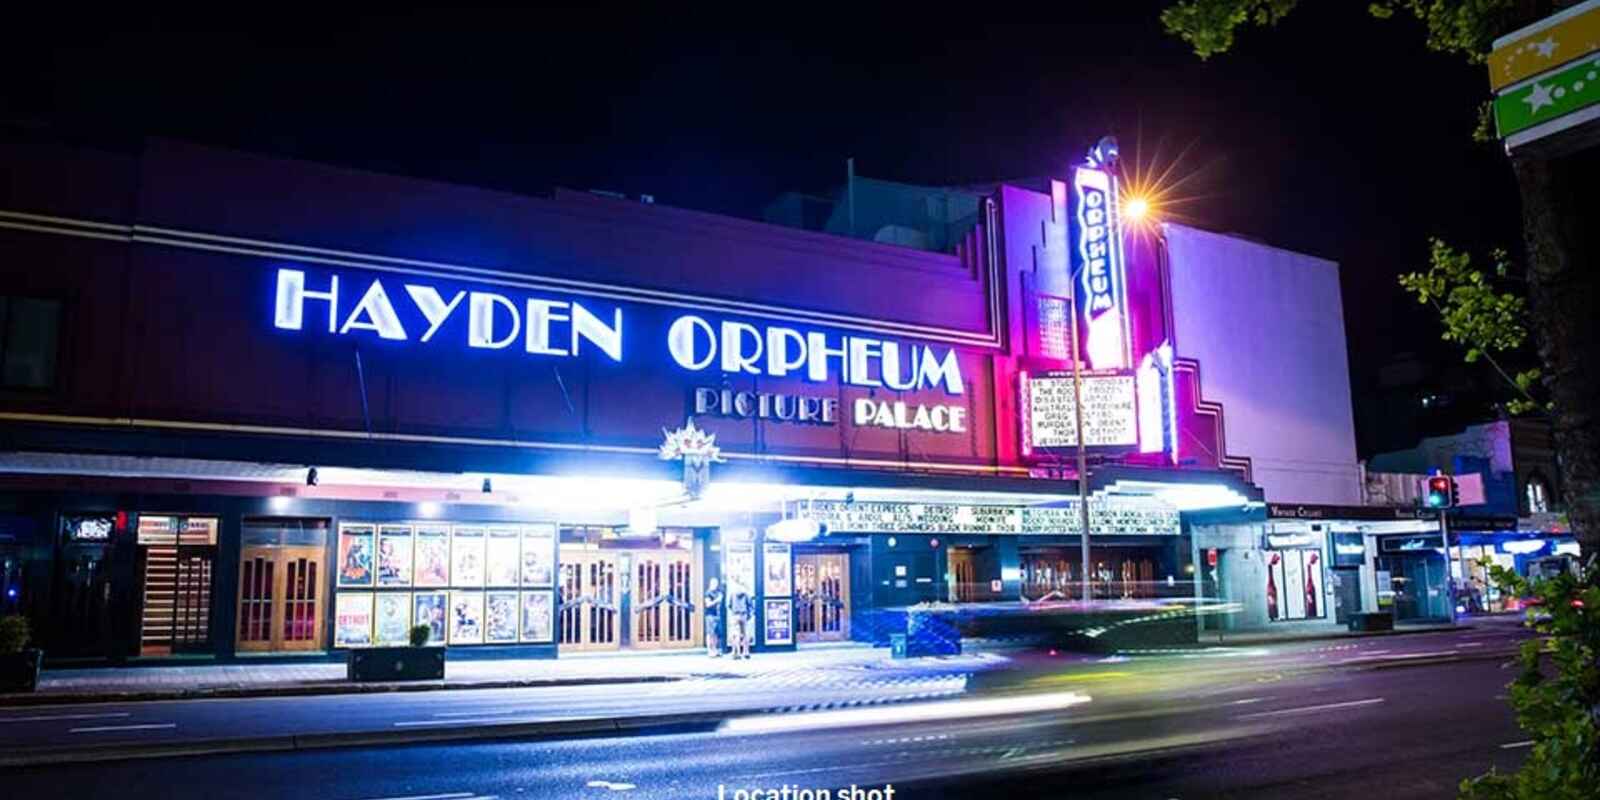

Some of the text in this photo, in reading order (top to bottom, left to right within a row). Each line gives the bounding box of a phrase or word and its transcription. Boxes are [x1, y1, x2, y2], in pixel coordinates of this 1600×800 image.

[1086, 191, 1113, 311] ORPHEUM
[274, 268, 965, 395] HAYDEN ORPHEUM
[695, 388, 967, 432] PICTURE PALACE
[1056, 387, 1076, 396] ROO
